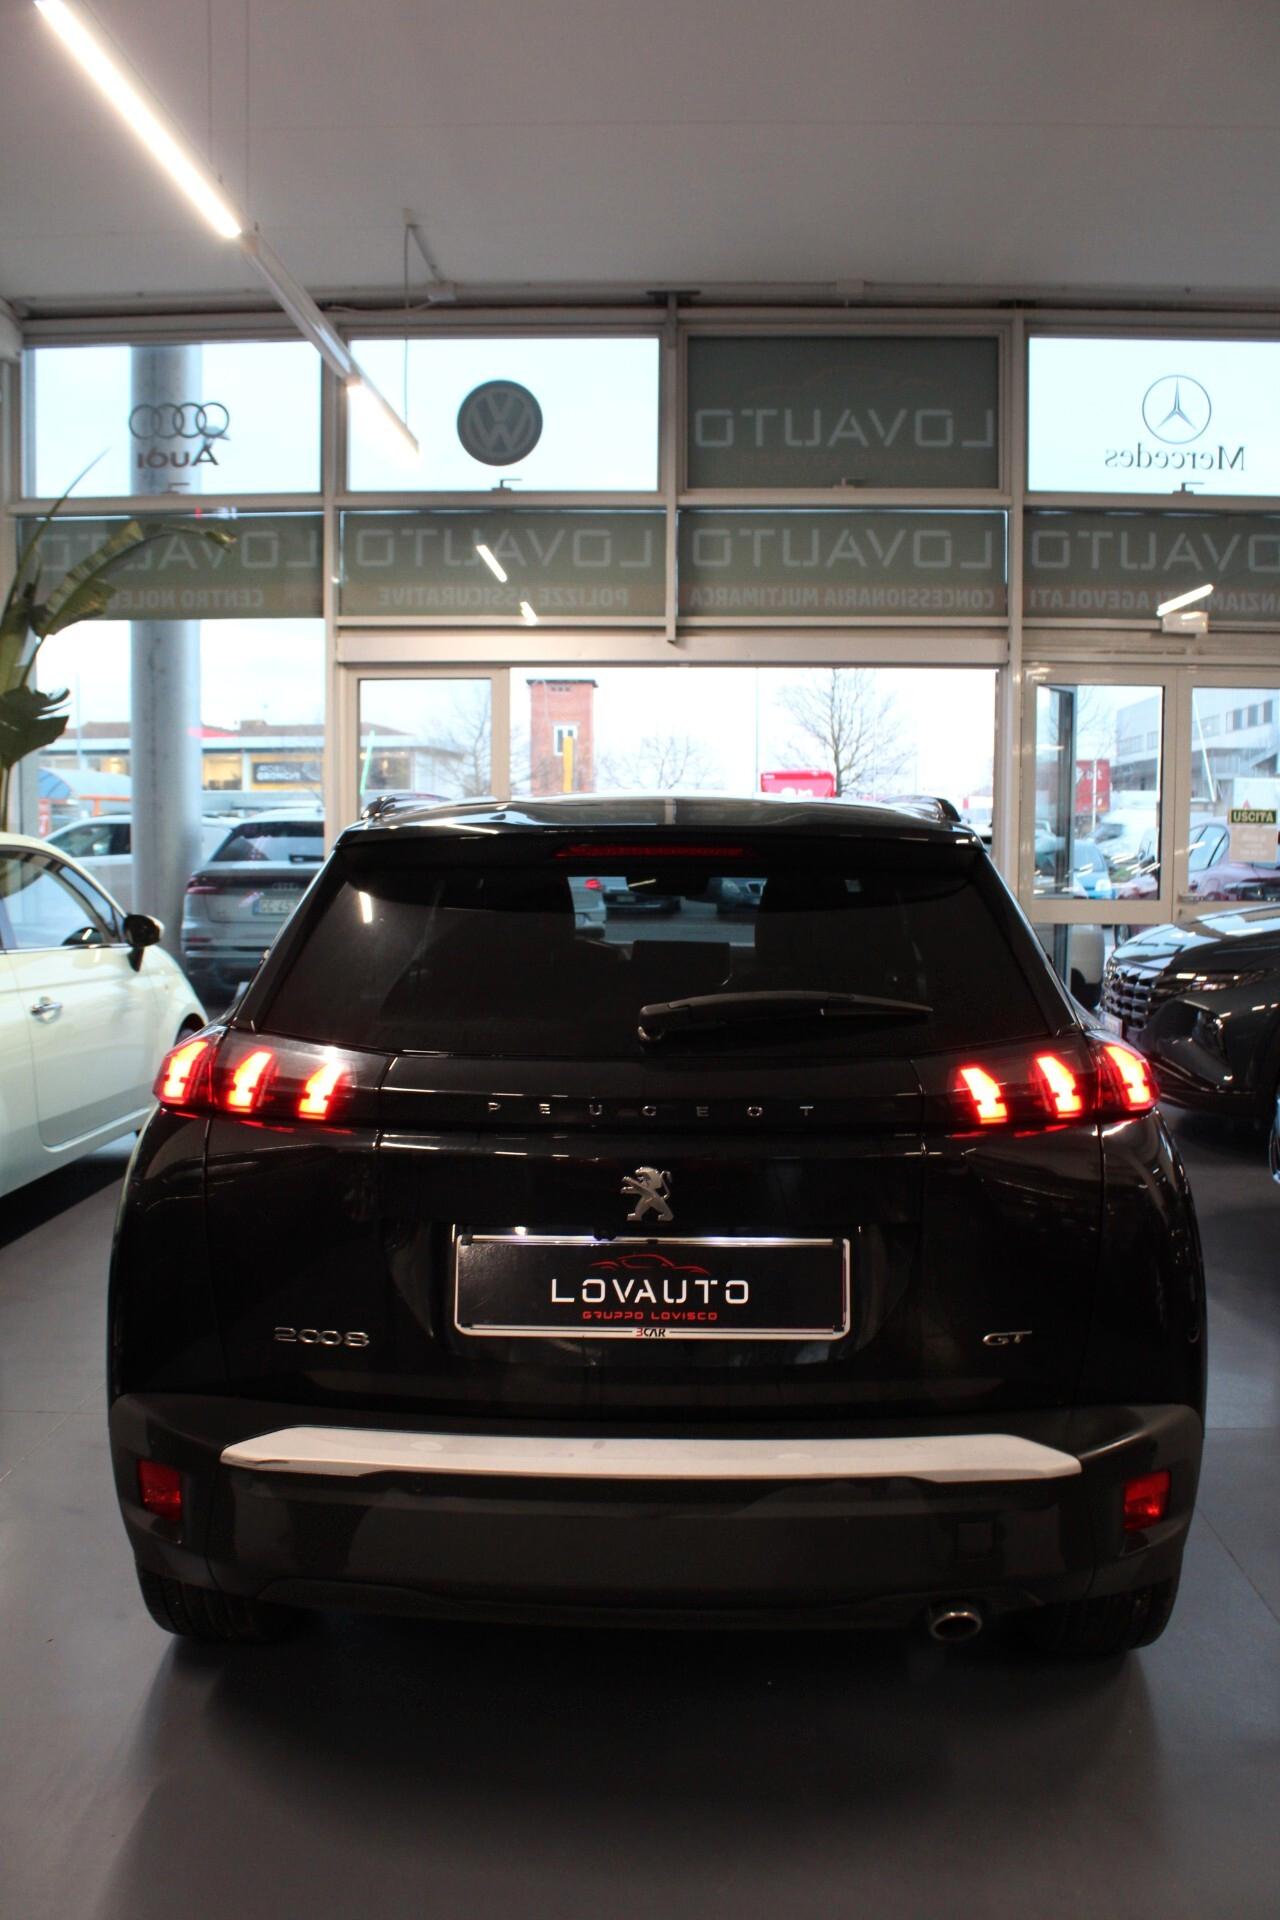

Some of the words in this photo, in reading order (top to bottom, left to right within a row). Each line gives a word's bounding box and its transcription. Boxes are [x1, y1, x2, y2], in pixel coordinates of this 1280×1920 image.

[1232, 811, 1274, 823] USCITA
[487, 1101, 815, 1118] PEUGEOT
[551, 1278, 750, 1305] LOVAUTO
[582, 1311, 645, 1321] GRUPPO
[650, 1311, 718, 1321] LOVISCO
[273, 1326, 370, 1347] 2008
[982, 1330, 1033, 1346] GT
